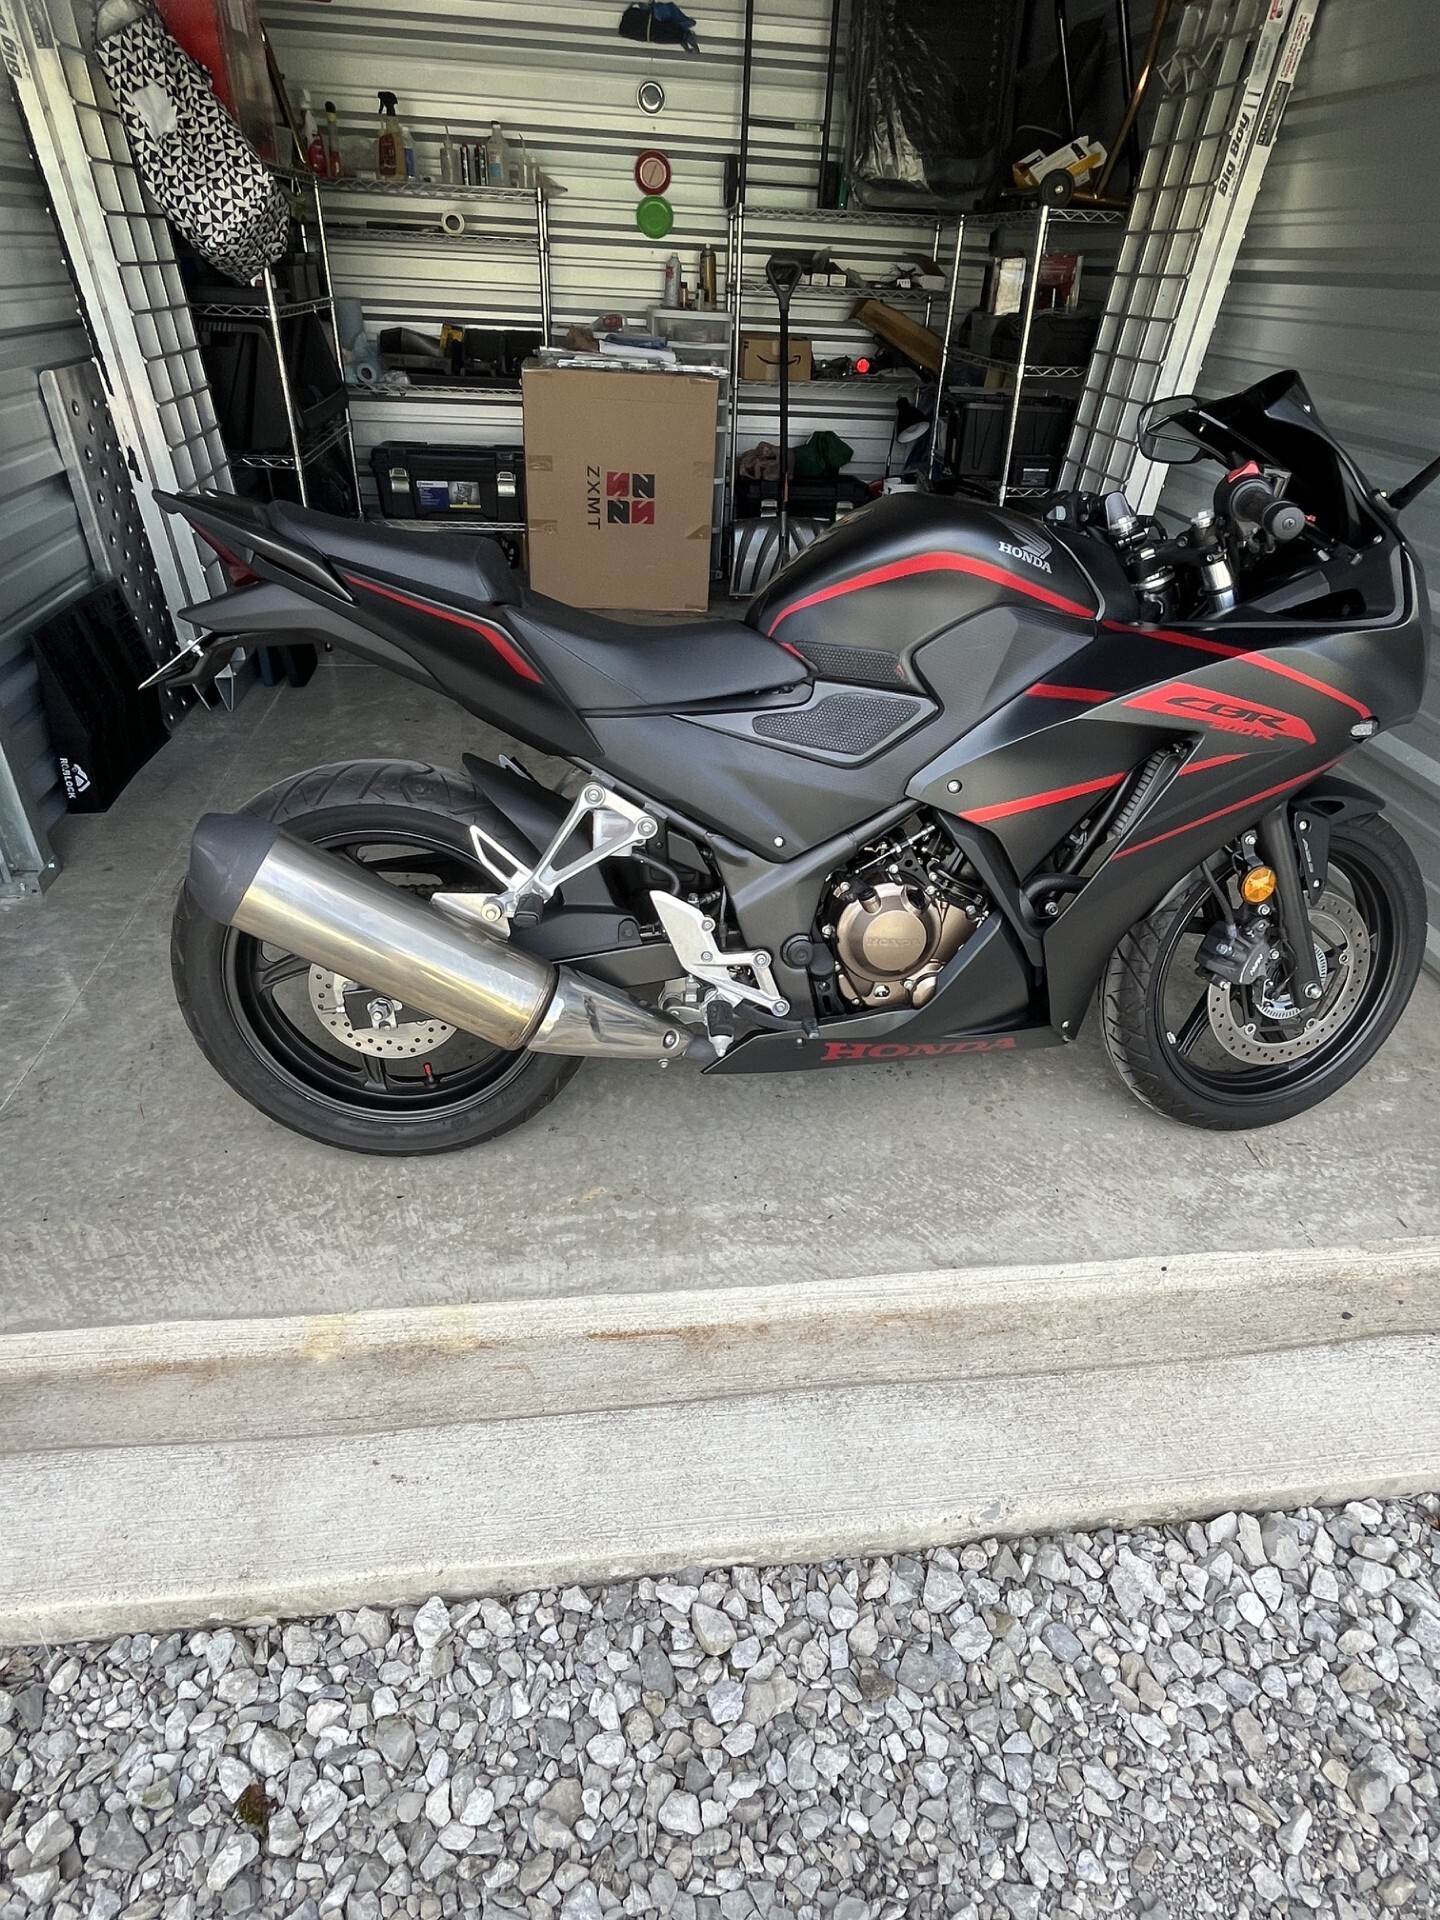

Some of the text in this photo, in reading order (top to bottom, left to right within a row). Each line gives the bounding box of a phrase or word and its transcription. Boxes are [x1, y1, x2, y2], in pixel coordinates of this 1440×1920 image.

[1218, 160, 1236, 197] Big
[1230, 112, 1250, 158] Boy
[587, 465, 601, 531] ZXMT
[998, 541, 1053, 574] HONDA
[1165, 697, 1288, 732] CBR
[866, 936, 921, 946] HONDA
[820, 1037, 1017, 1061] HONDA
